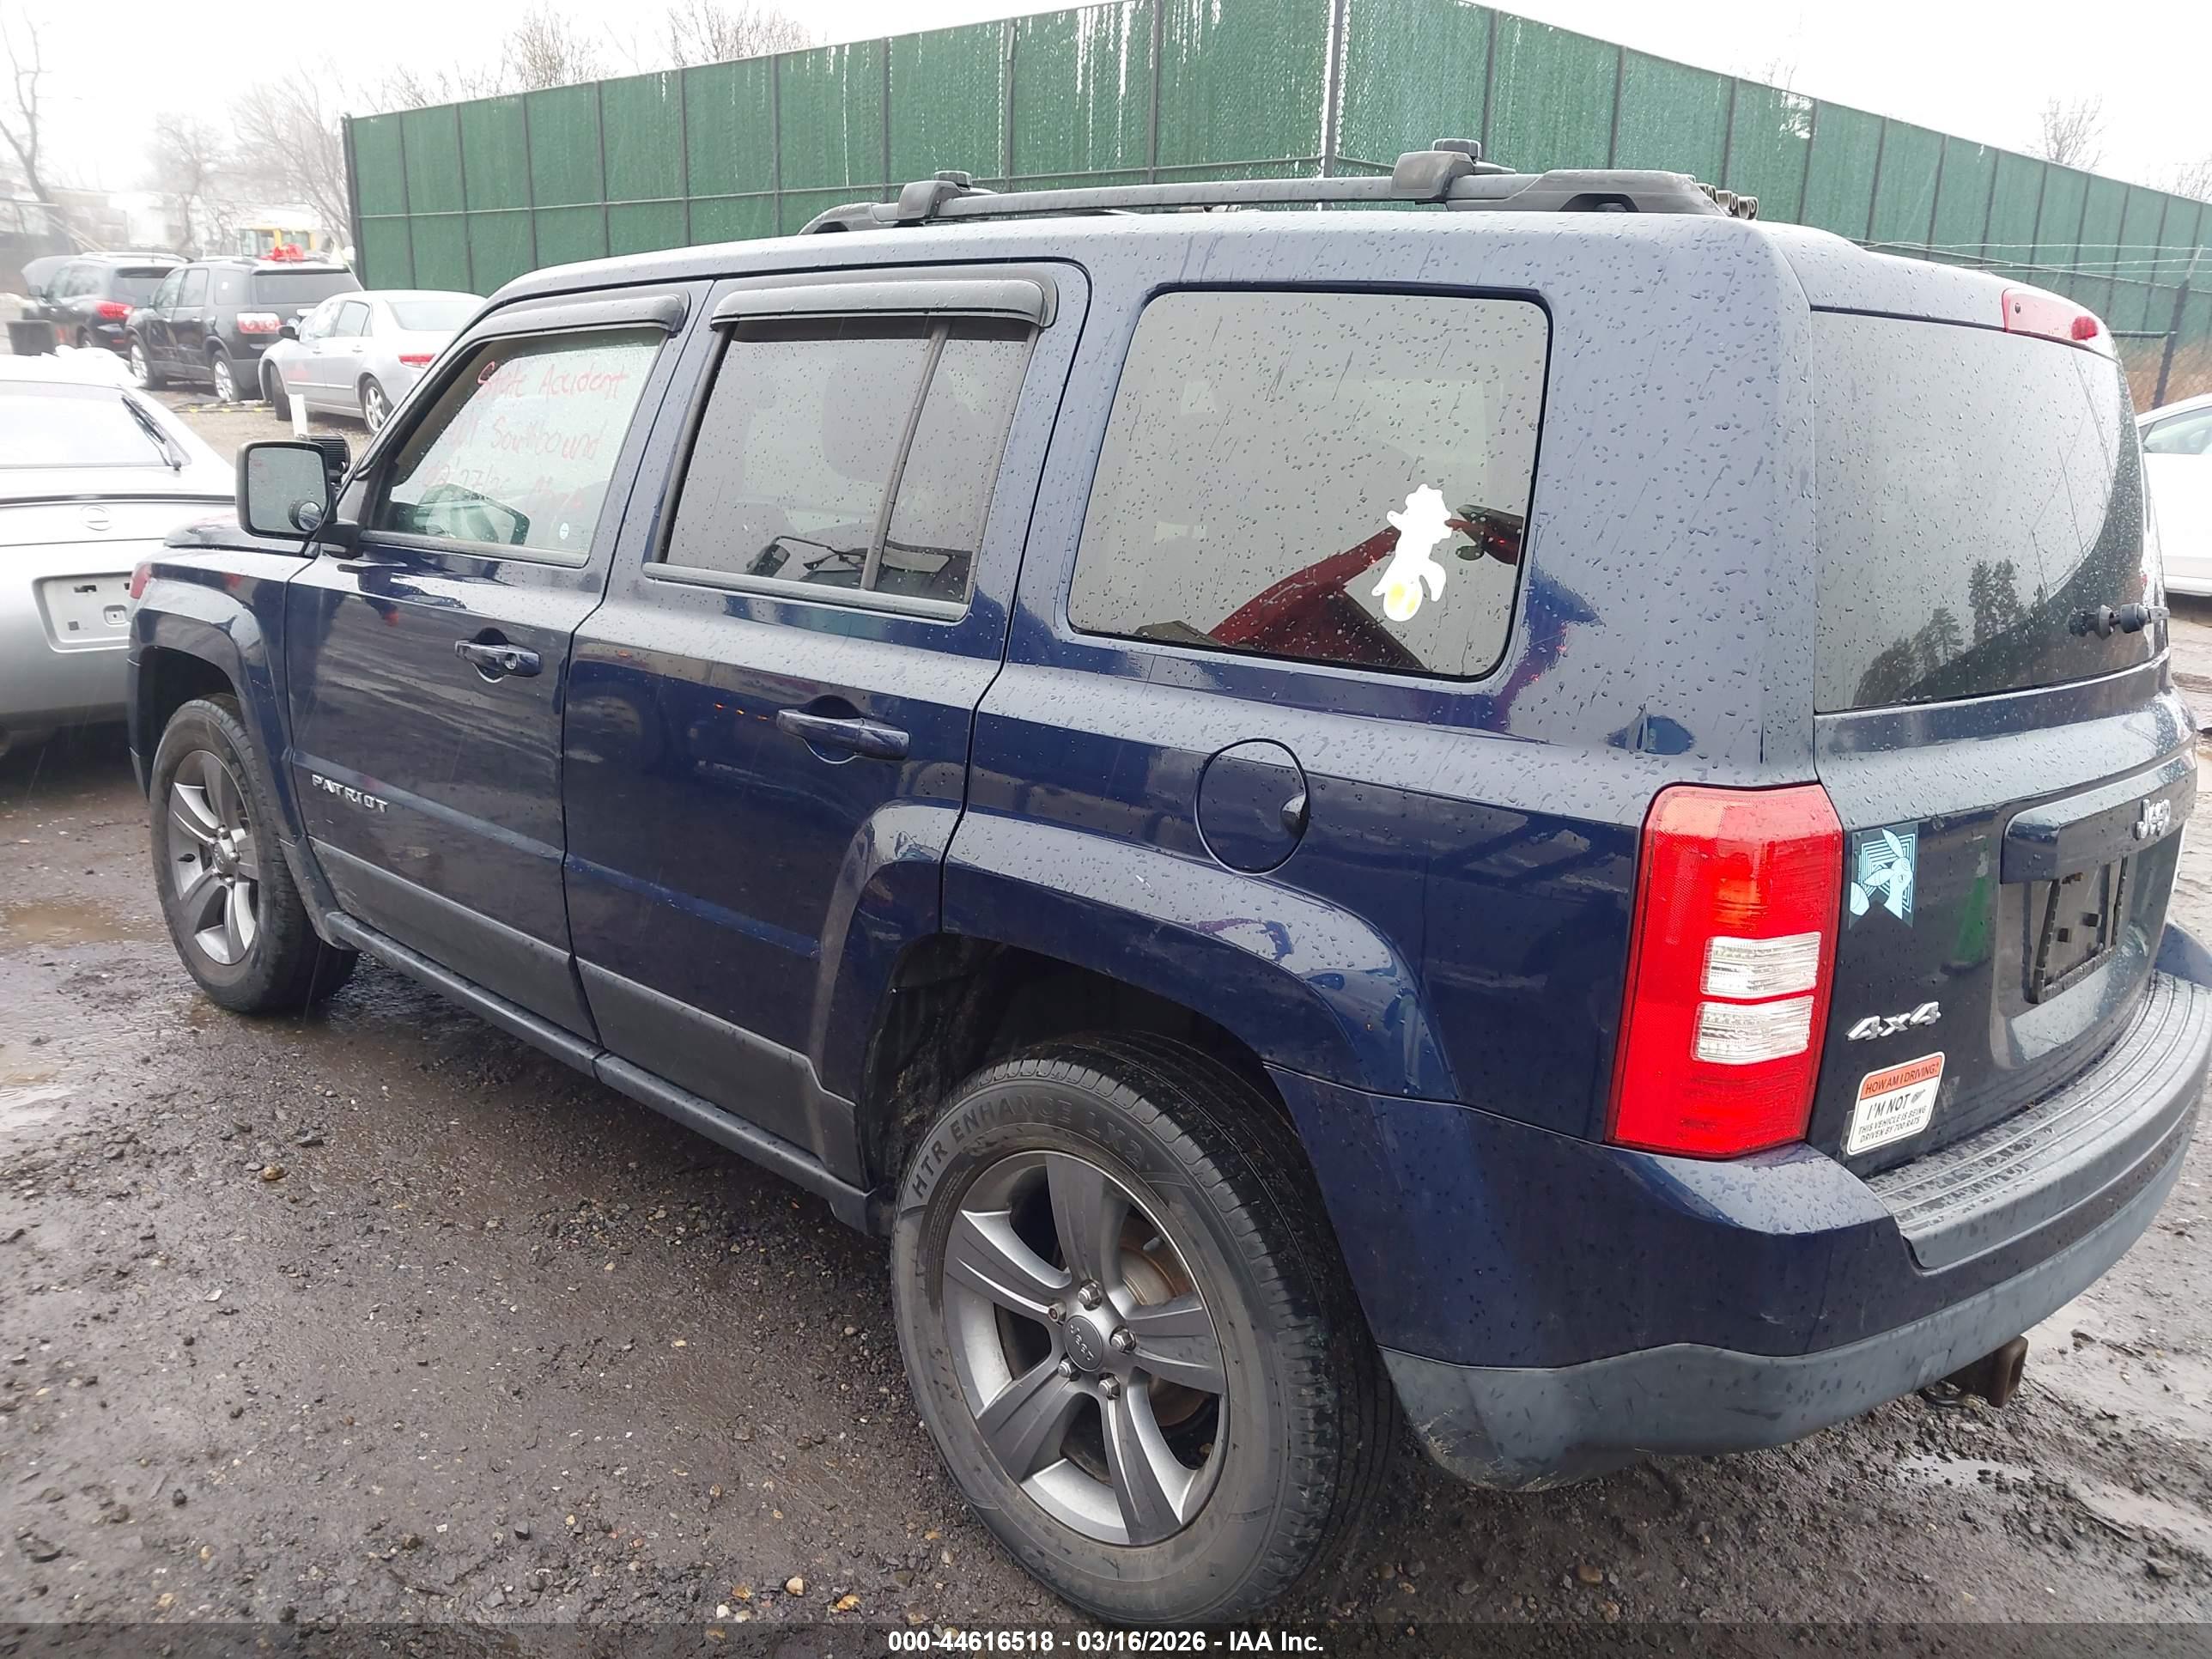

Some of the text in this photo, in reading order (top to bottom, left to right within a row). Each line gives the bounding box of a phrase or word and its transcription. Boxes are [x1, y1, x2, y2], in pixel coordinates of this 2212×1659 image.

[538, 363, 630, 402] Accident
[312, 774, 389, 812] PATRIOT
[1865, 1079, 1887, 1095] HOW
[1887, 1075, 1899, 1089] AM
[1859, 1122, 1875, 1135] THIS
[1874, 1114, 1901, 1130] VEHICLE
[1907, 1105, 1927, 1119] BEING
[1867, 1093, 1911, 1120] I'M NOT
[912, 1140, 948, 1199] HTR
[950, 1095, 1073, 1144] ENHANCE
[1860, 1128, 1884, 1143] DRIVEN
[1884, 1126, 1893, 1135] BY
